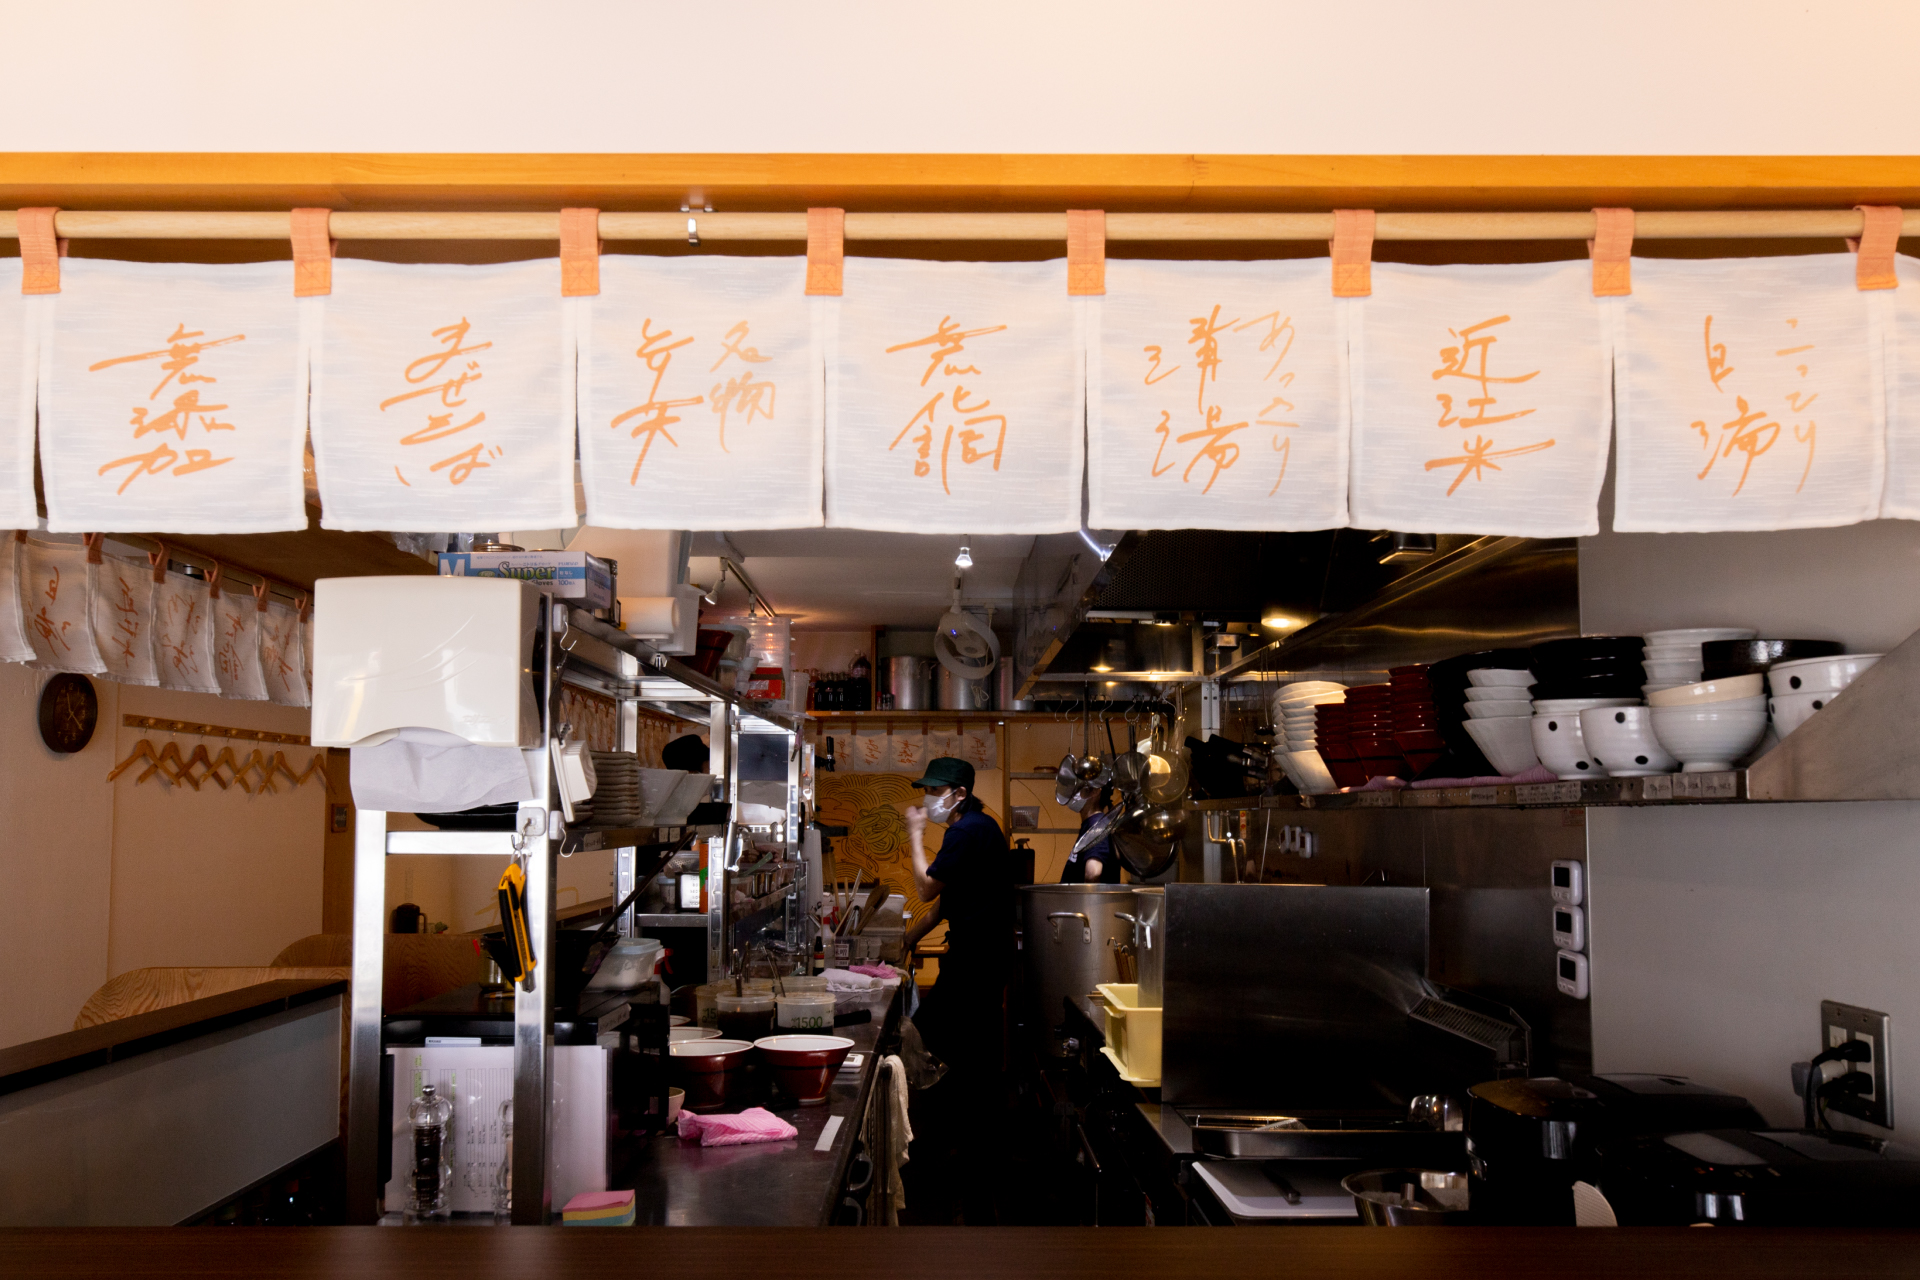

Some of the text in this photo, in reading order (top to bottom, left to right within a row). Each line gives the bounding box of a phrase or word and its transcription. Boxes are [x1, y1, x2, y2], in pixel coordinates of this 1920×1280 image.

[89, 323, 245, 494] 無添加
[380, 317, 502, 486] まぜそば
[709, 320, 775, 453] 名物
[886, 315, 1007, 495] 無化調
[1233, 310, 1299, 497] あっさり
[1425, 314, 1555, 497] 近江米
[1690, 315, 1779, 497] 白湯
[1776, 317, 1819, 494] こってり
[498, 561, 556, 580] Super
[796, 1016, 822, 1029] 1500
